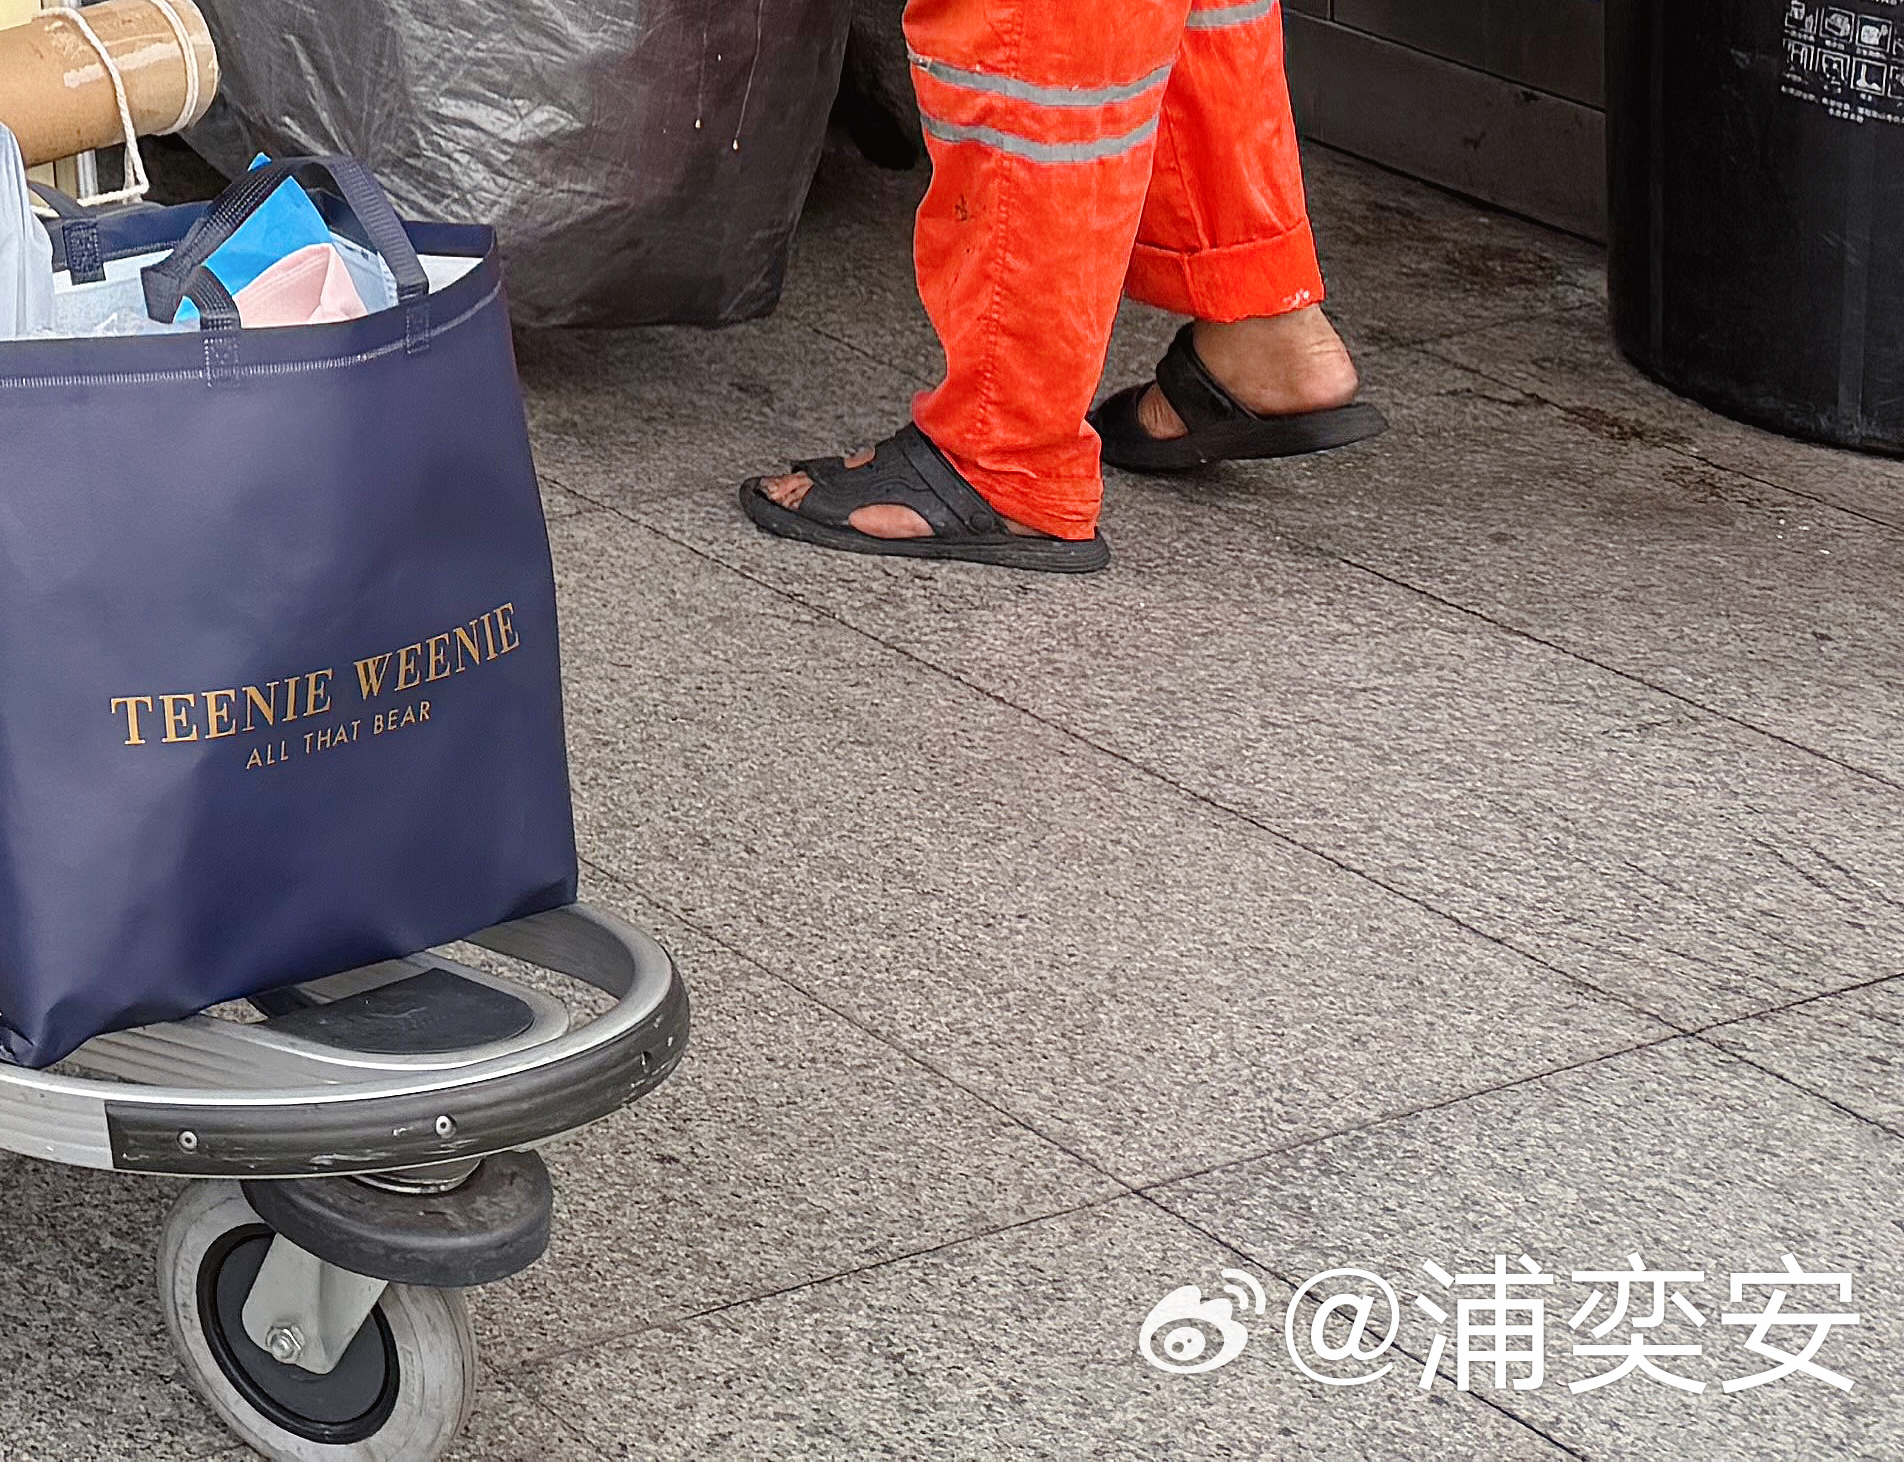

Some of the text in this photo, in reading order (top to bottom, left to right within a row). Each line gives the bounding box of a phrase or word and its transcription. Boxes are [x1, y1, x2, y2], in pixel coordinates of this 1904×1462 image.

[110, 601, 521, 746] TEENIE WEENIE
[244, 699, 432, 770] ALL THAT BEAR
